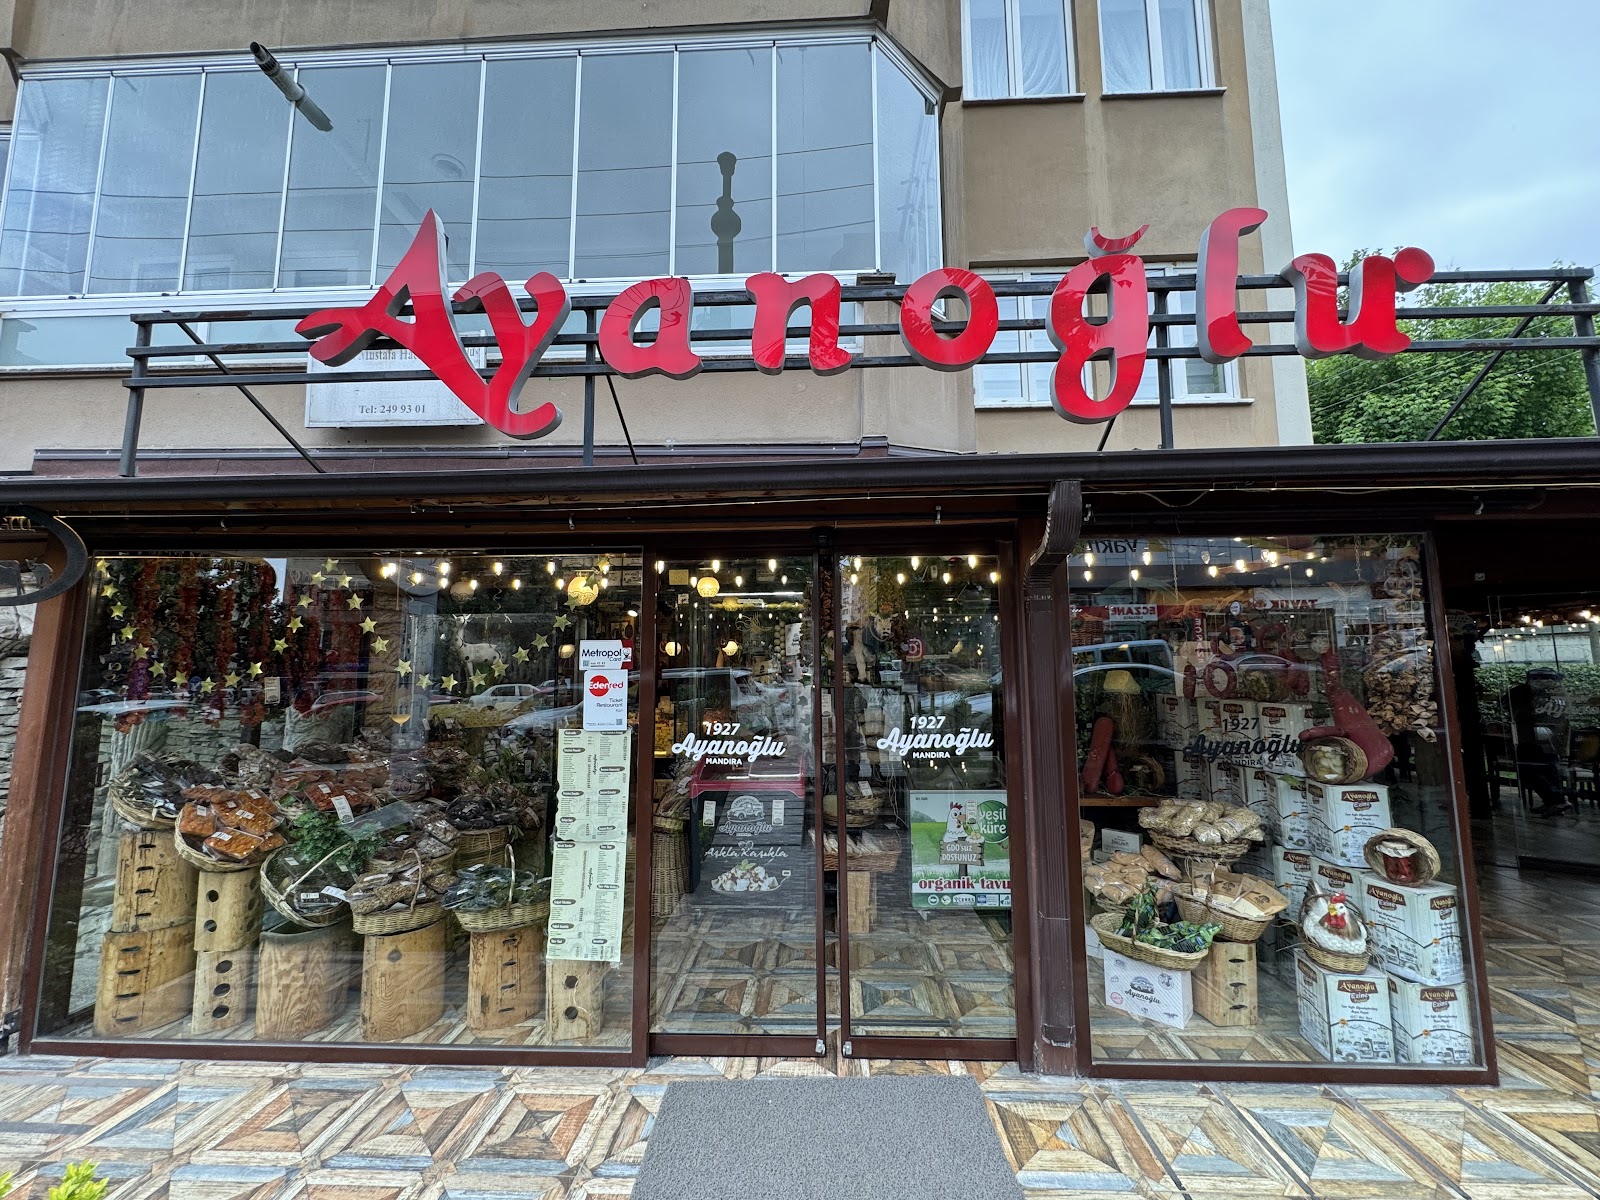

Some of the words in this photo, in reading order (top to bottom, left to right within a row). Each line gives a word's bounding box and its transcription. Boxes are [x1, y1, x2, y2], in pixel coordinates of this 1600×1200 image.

[295, 207, 1436, 438] Ayanoğlu
[358, 404, 377, 414] Tel:
[379, 404, 398, 414] 249
[400, 404, 412, 413] 93
[415, 403, 426, 413] 01
[582, 648, 622, 661] Metropol
[589, 680, 624, 690] Edenred
[705, 722, 741, 736] 1927
[909, 715, 946, 729] 1927
[1222, 717, 1259, 731] 1927
[671, 733, 786, 763] Ayanoğlu
[876, 727, 994, 757] Ayanoğlu
[705, 757, 743, 766] MANDIRA
[912, 751, 951, 759] MANDIRA
[978, 808, 1007, 822] yeşil
[980, 821, 1007, 835] küre
[946, 843, 973, 852] GDO'suz
[942, 853, 977, 862] DOSTUNUZ
[918, 876, 976, 892] organik
[1339, 981, 1376, 993] Ayanoğlu
